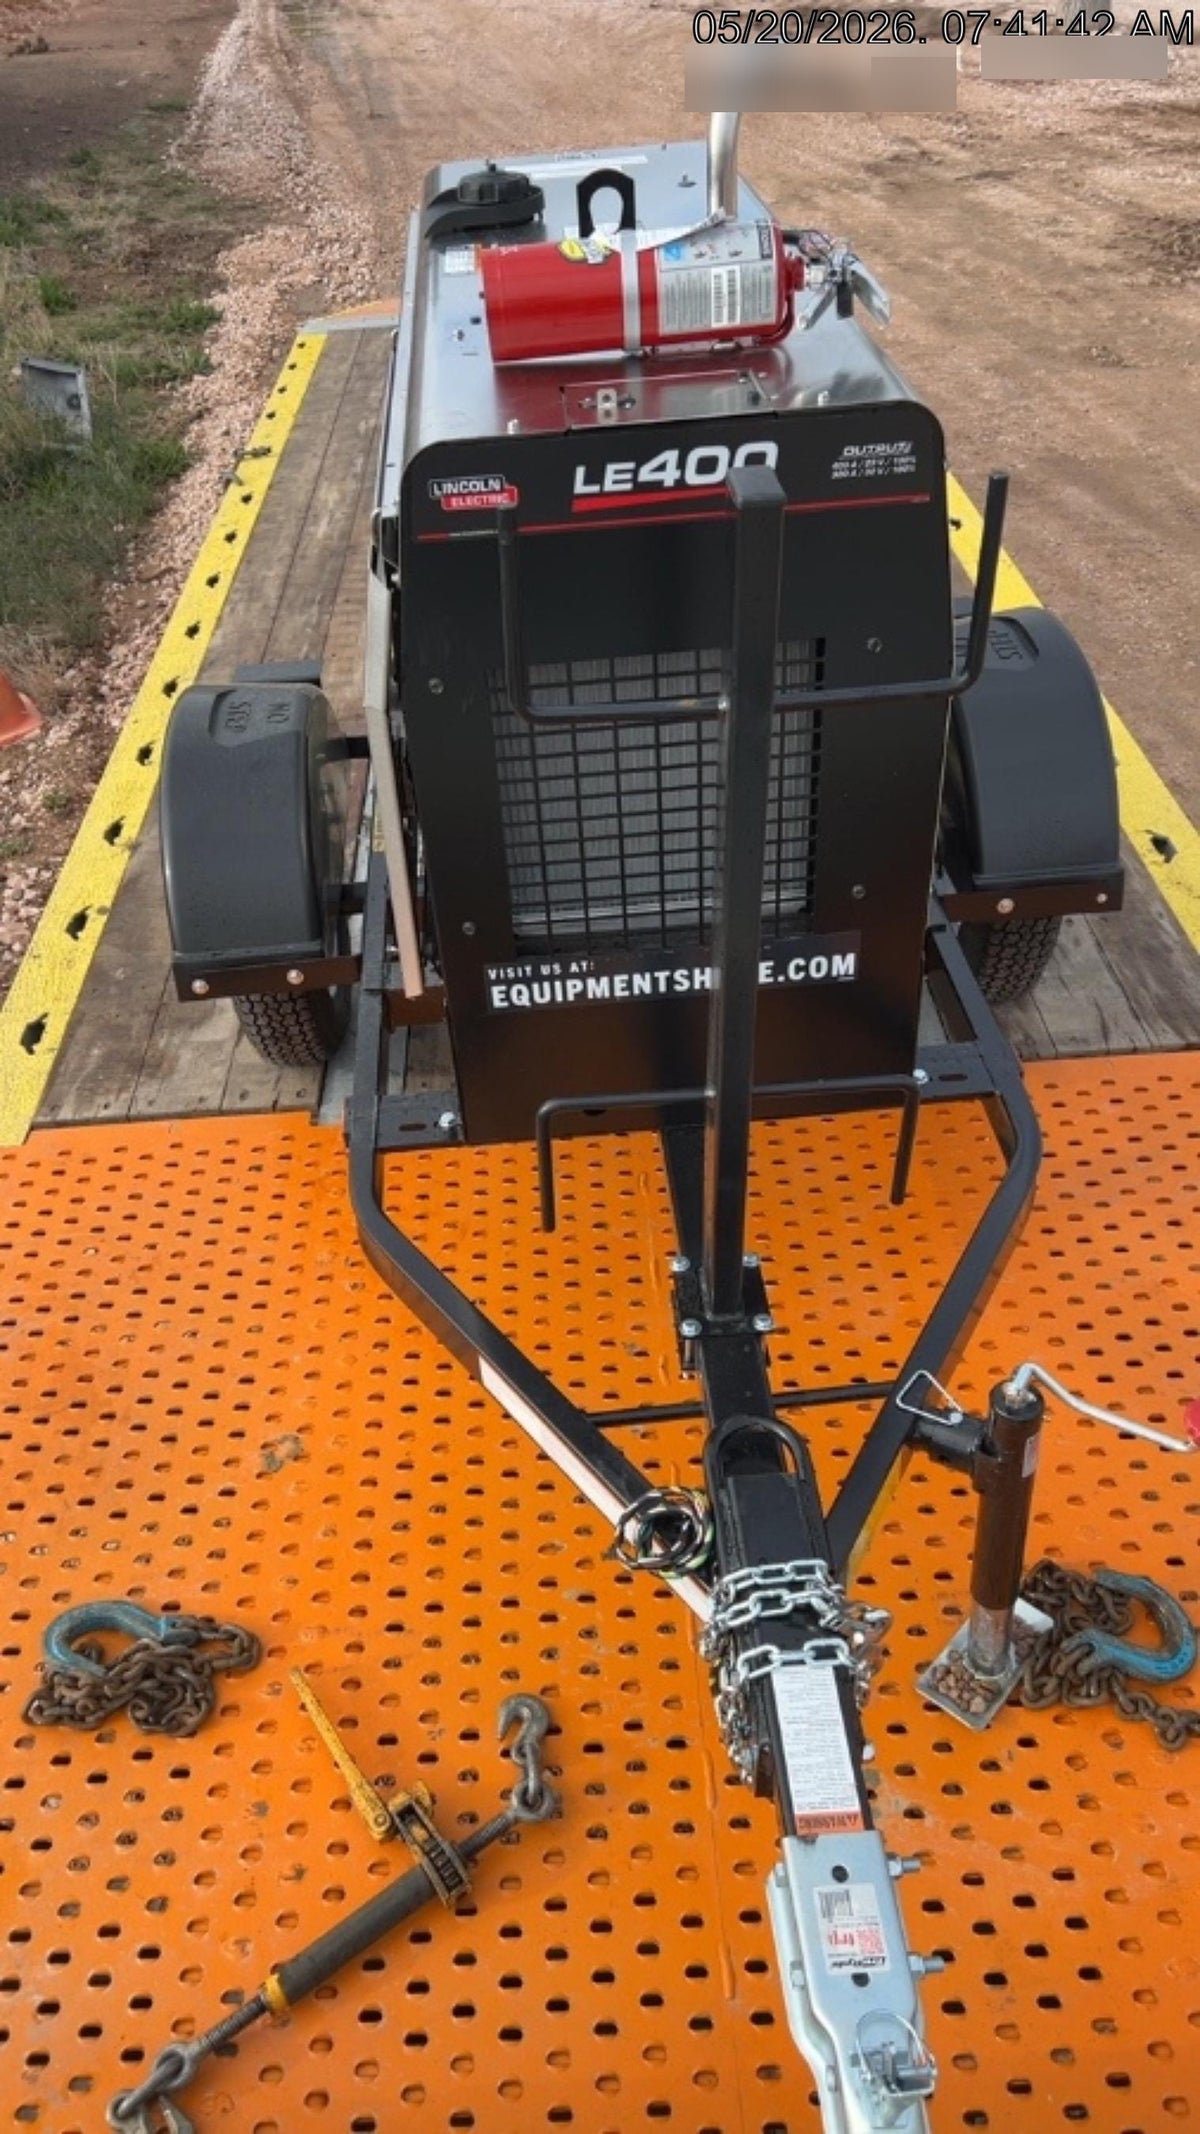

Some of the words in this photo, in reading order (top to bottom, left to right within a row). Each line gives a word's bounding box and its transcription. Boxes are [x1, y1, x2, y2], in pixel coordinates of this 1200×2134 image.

[573, 440, 779, 494] LE400
[432, 478, 501, 496] LINCOLN
[450, 492, 510, 507] ELECTRIC
[487, 964, 533, 980] VISIT
[539, 962, 562, 975] US
[569, 960, 595, 973] AT:
